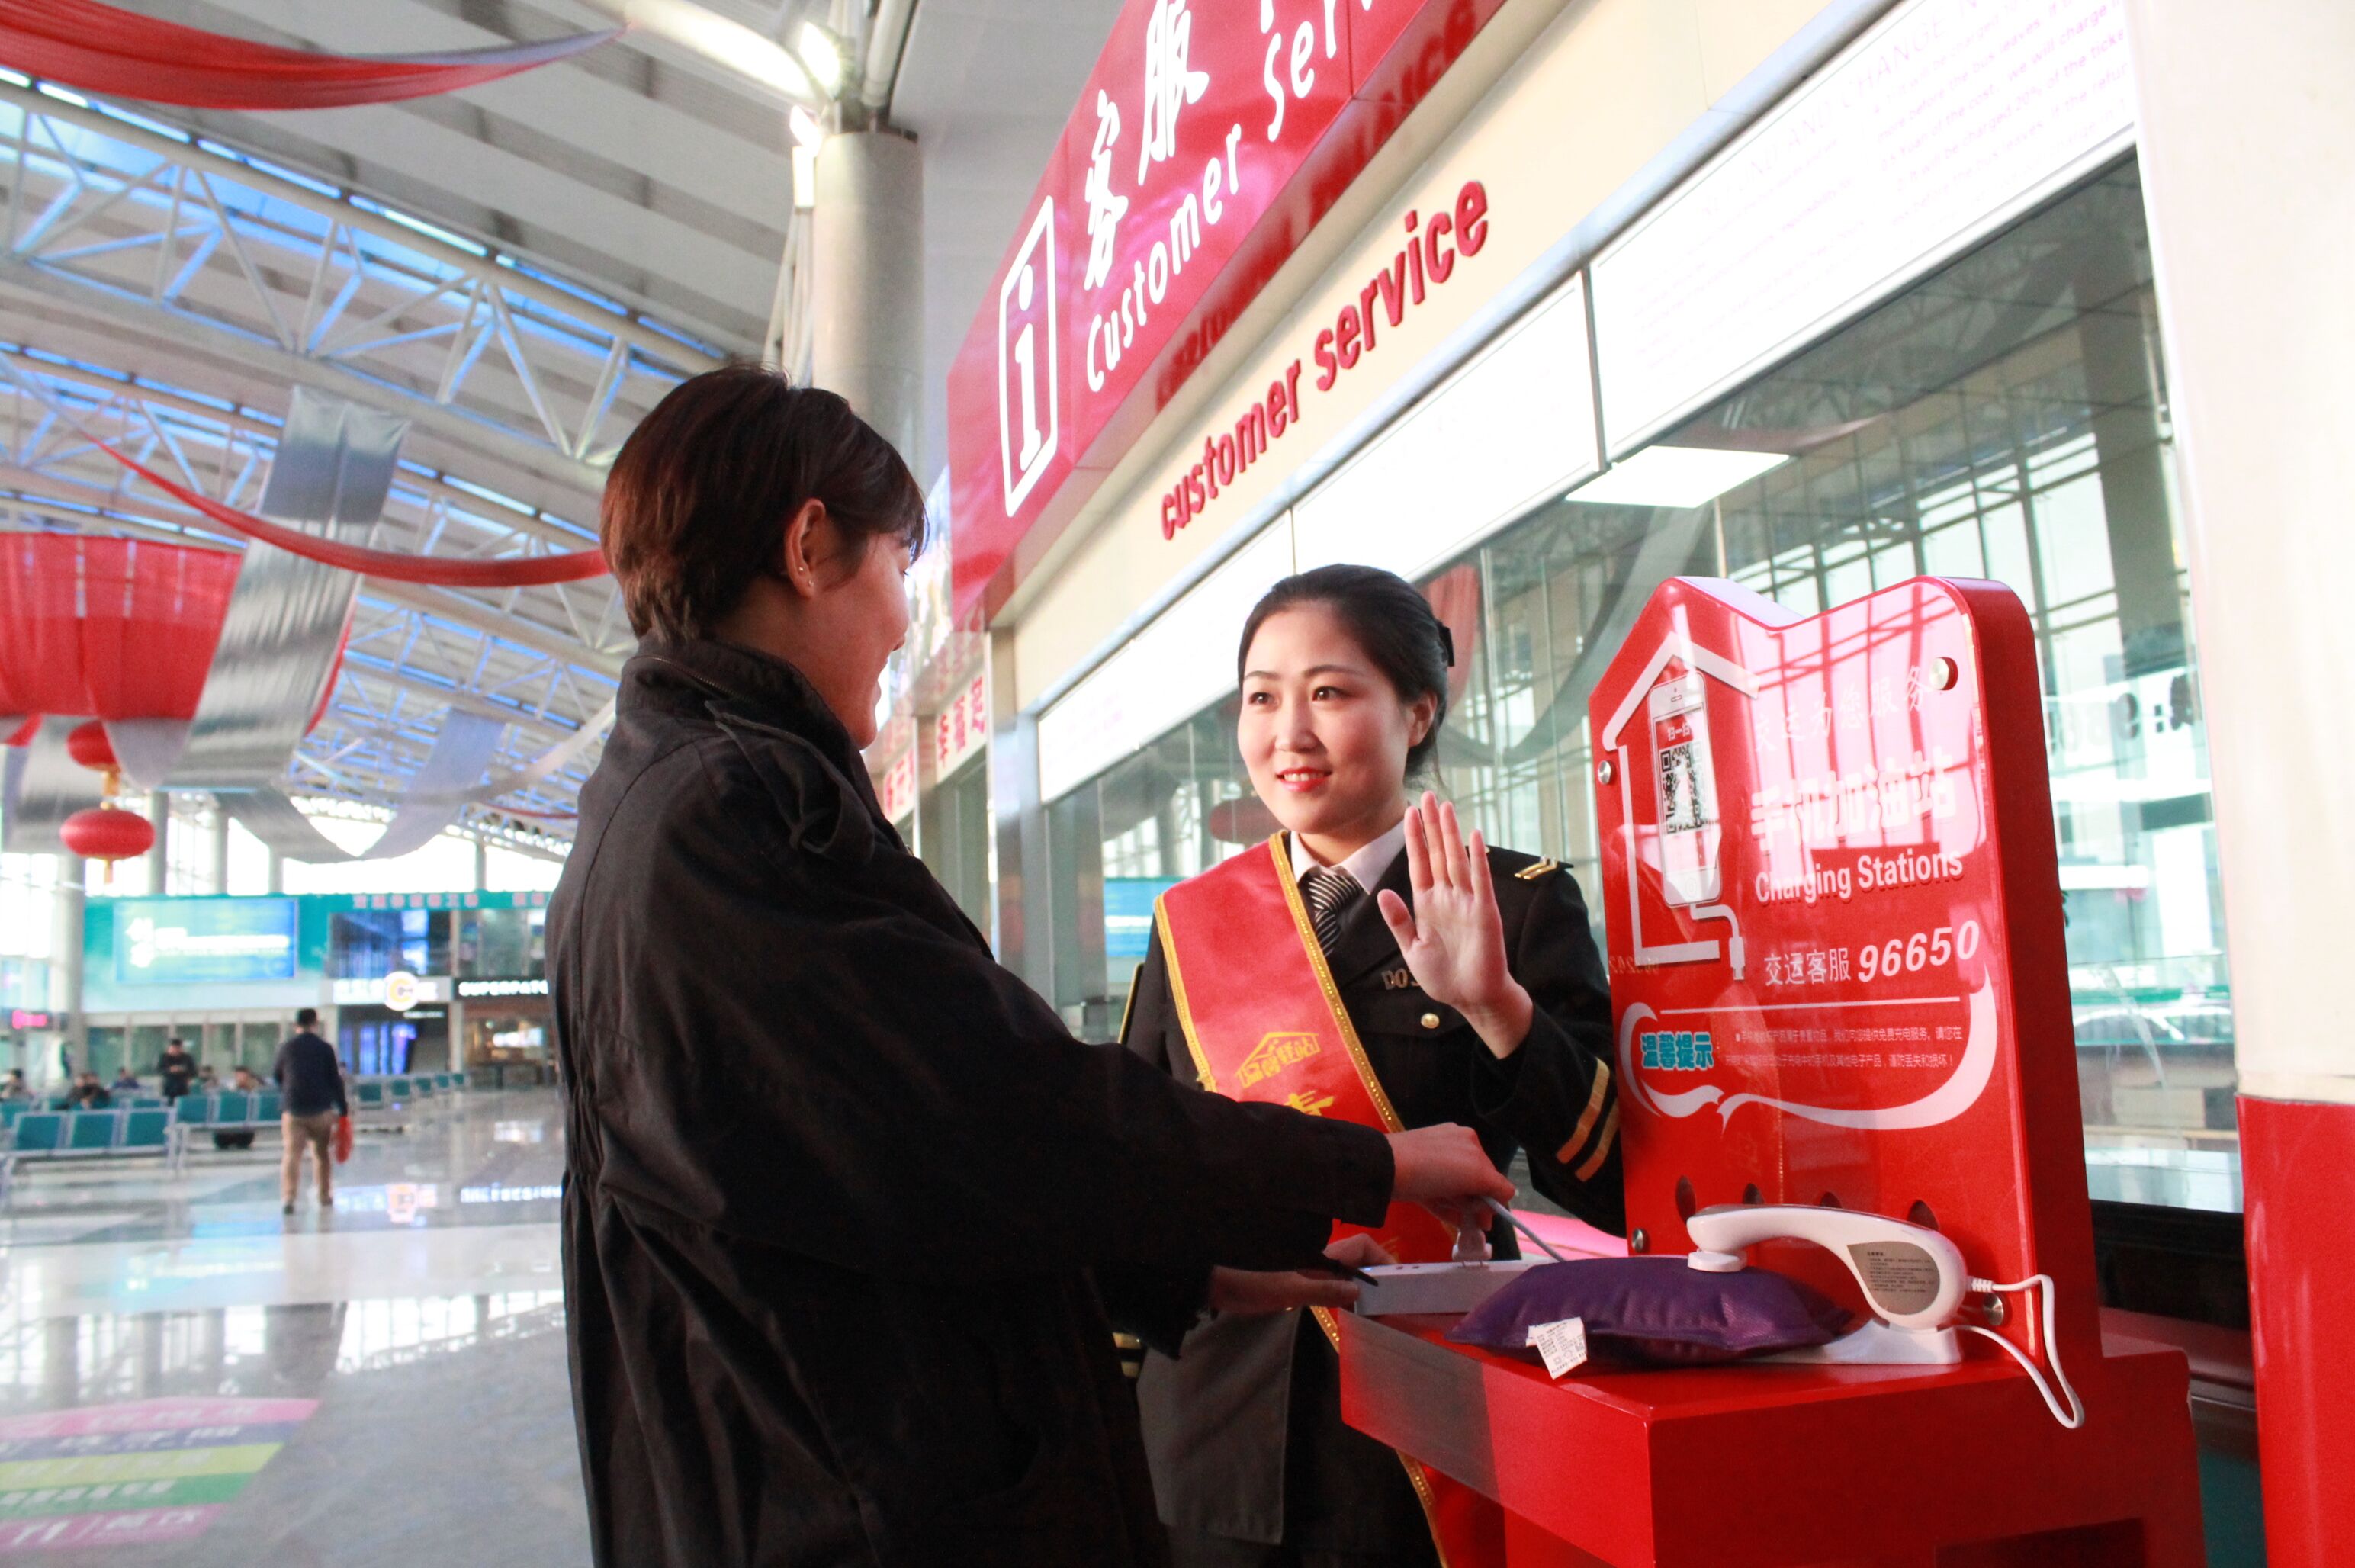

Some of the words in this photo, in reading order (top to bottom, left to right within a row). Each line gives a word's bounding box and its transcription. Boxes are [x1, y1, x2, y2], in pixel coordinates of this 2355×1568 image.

[2059, 4, 2108, 45] charge
[2063, 56, 2087, 77] the
[1161, 359, 1301, 540] customer
[1314, 180, 1489, 392] service
[1749, 745, 1958, 853] 手机加油站
[1756, 869, 1853, 904] Charging
[1858, 849, 1964, 889] Stations
[1763, 947, 1851, 986] 交运客服
[1858, 919, 1981, 983] 96650
[1640, 1030, 1715, 1071] 温馨提示
